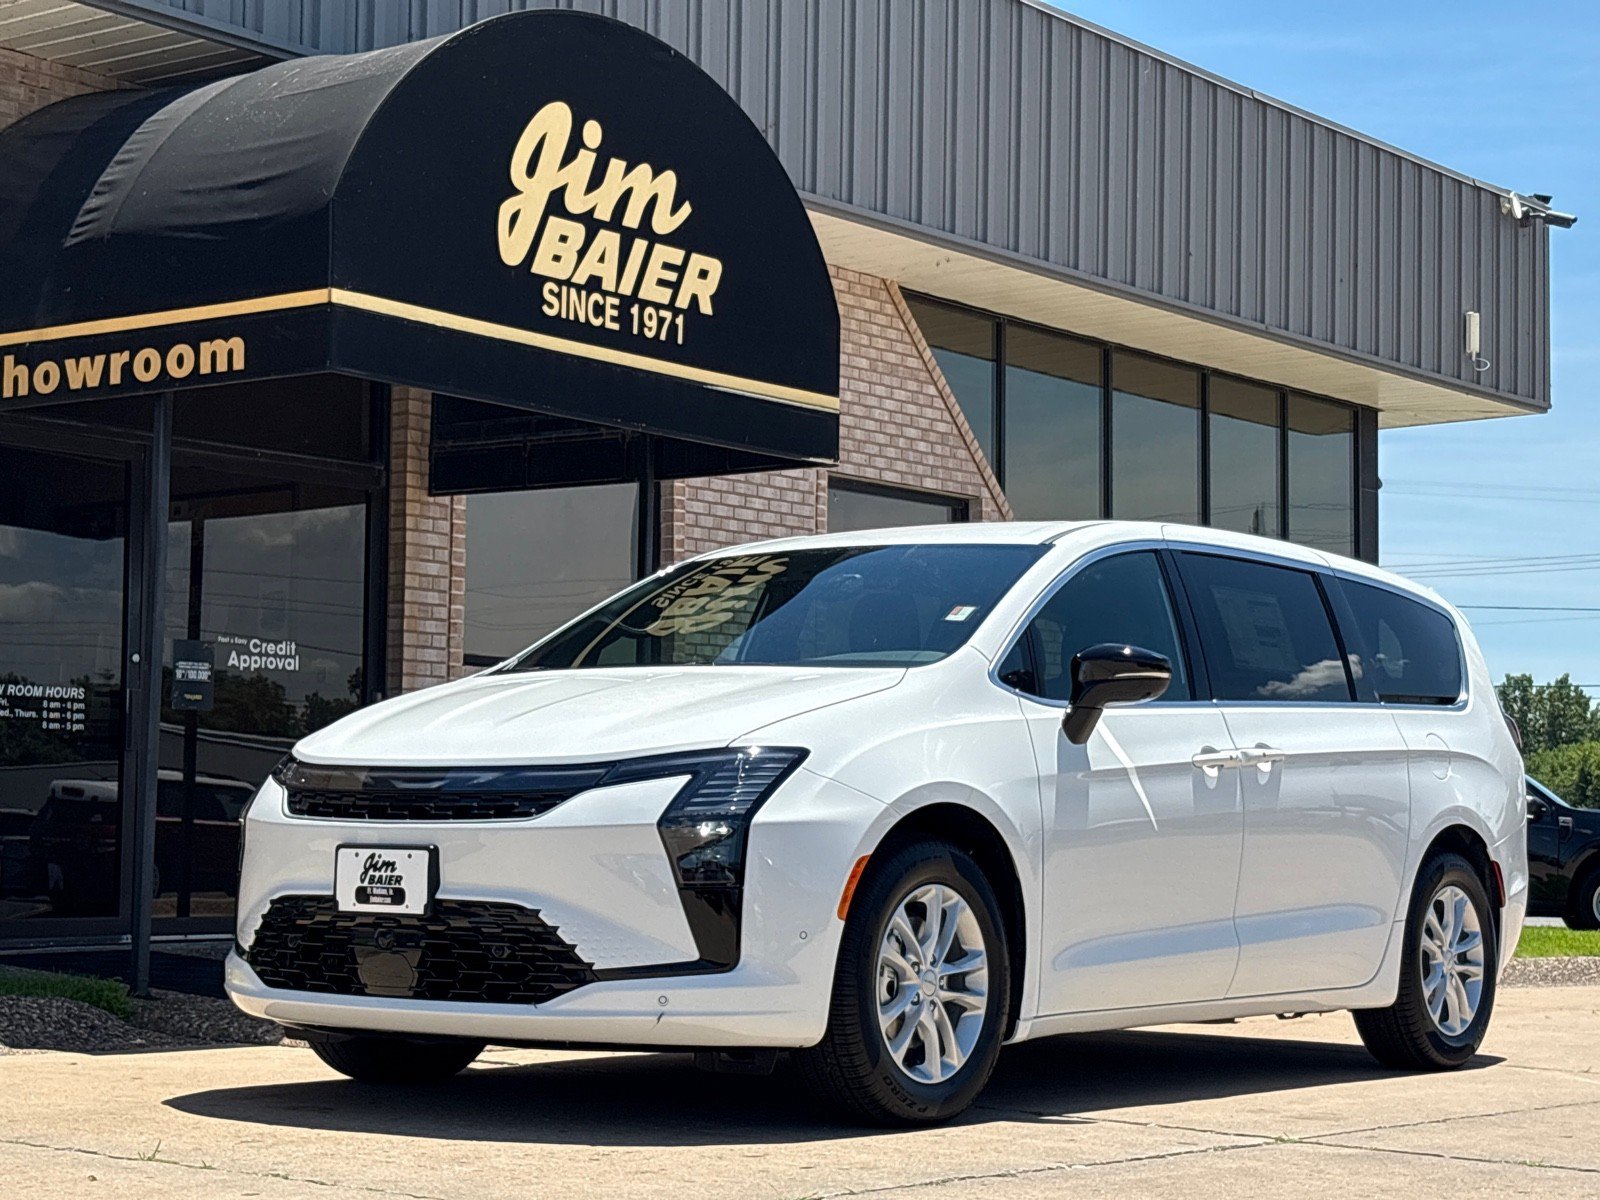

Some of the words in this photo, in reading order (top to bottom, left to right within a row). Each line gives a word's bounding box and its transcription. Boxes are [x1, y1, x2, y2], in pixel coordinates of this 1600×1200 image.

[498, 101, 692, 266] Jim
[531, 216, 723, 316] BAIER
[542, 282, 620, 331] SINCE
[630, 304, 685, 345] 1971
[249, 639, 296, 655] Credit
[227, 650, 299, 671] Approval
[7, 684, 43, 697] ROOM
[45, 686, 85, 699] HOURS
[43, 700, 48, 708] 8
[73, 702, 85, 711] pm
[14, 709, 38, 718] Thurs.
[42, 711, 47, 719] 8
[73, 713, 85, 721] pm
[42, 721, 47, 729] 8
[66, 722, 71, 730] 5
[72, 723, 84, 732] pm
[360, 852, 397, 884] Jim
[368, 874, 403, 886] BAIER
